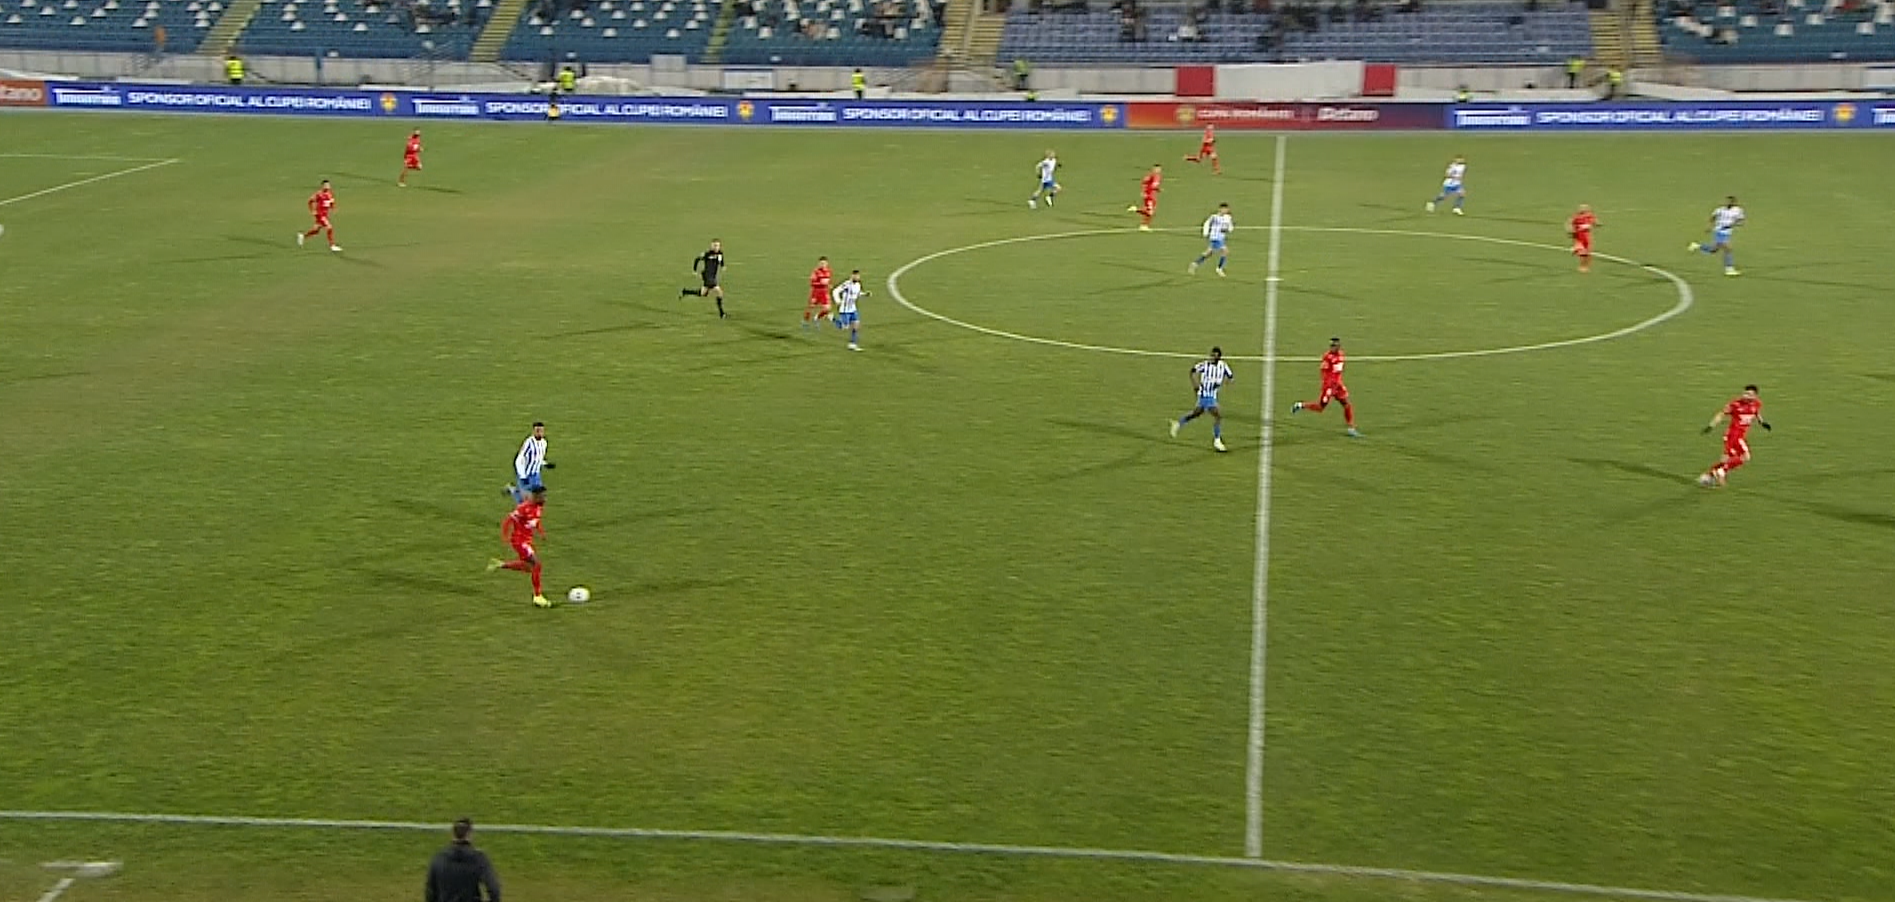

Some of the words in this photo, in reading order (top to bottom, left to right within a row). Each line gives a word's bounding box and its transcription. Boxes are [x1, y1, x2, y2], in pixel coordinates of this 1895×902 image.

[127, 92, 194, 105] SPONSOR
[195, 94, 245, 107] OFICIAL
[247, 95, 265, 108] AL
[484, 101, 549, 114] SPONSOR
[550, 103, 602, 115] FICIAL
[603, 103, 621, 116] AL
[842, 108, 907, 120] SPONSOR
